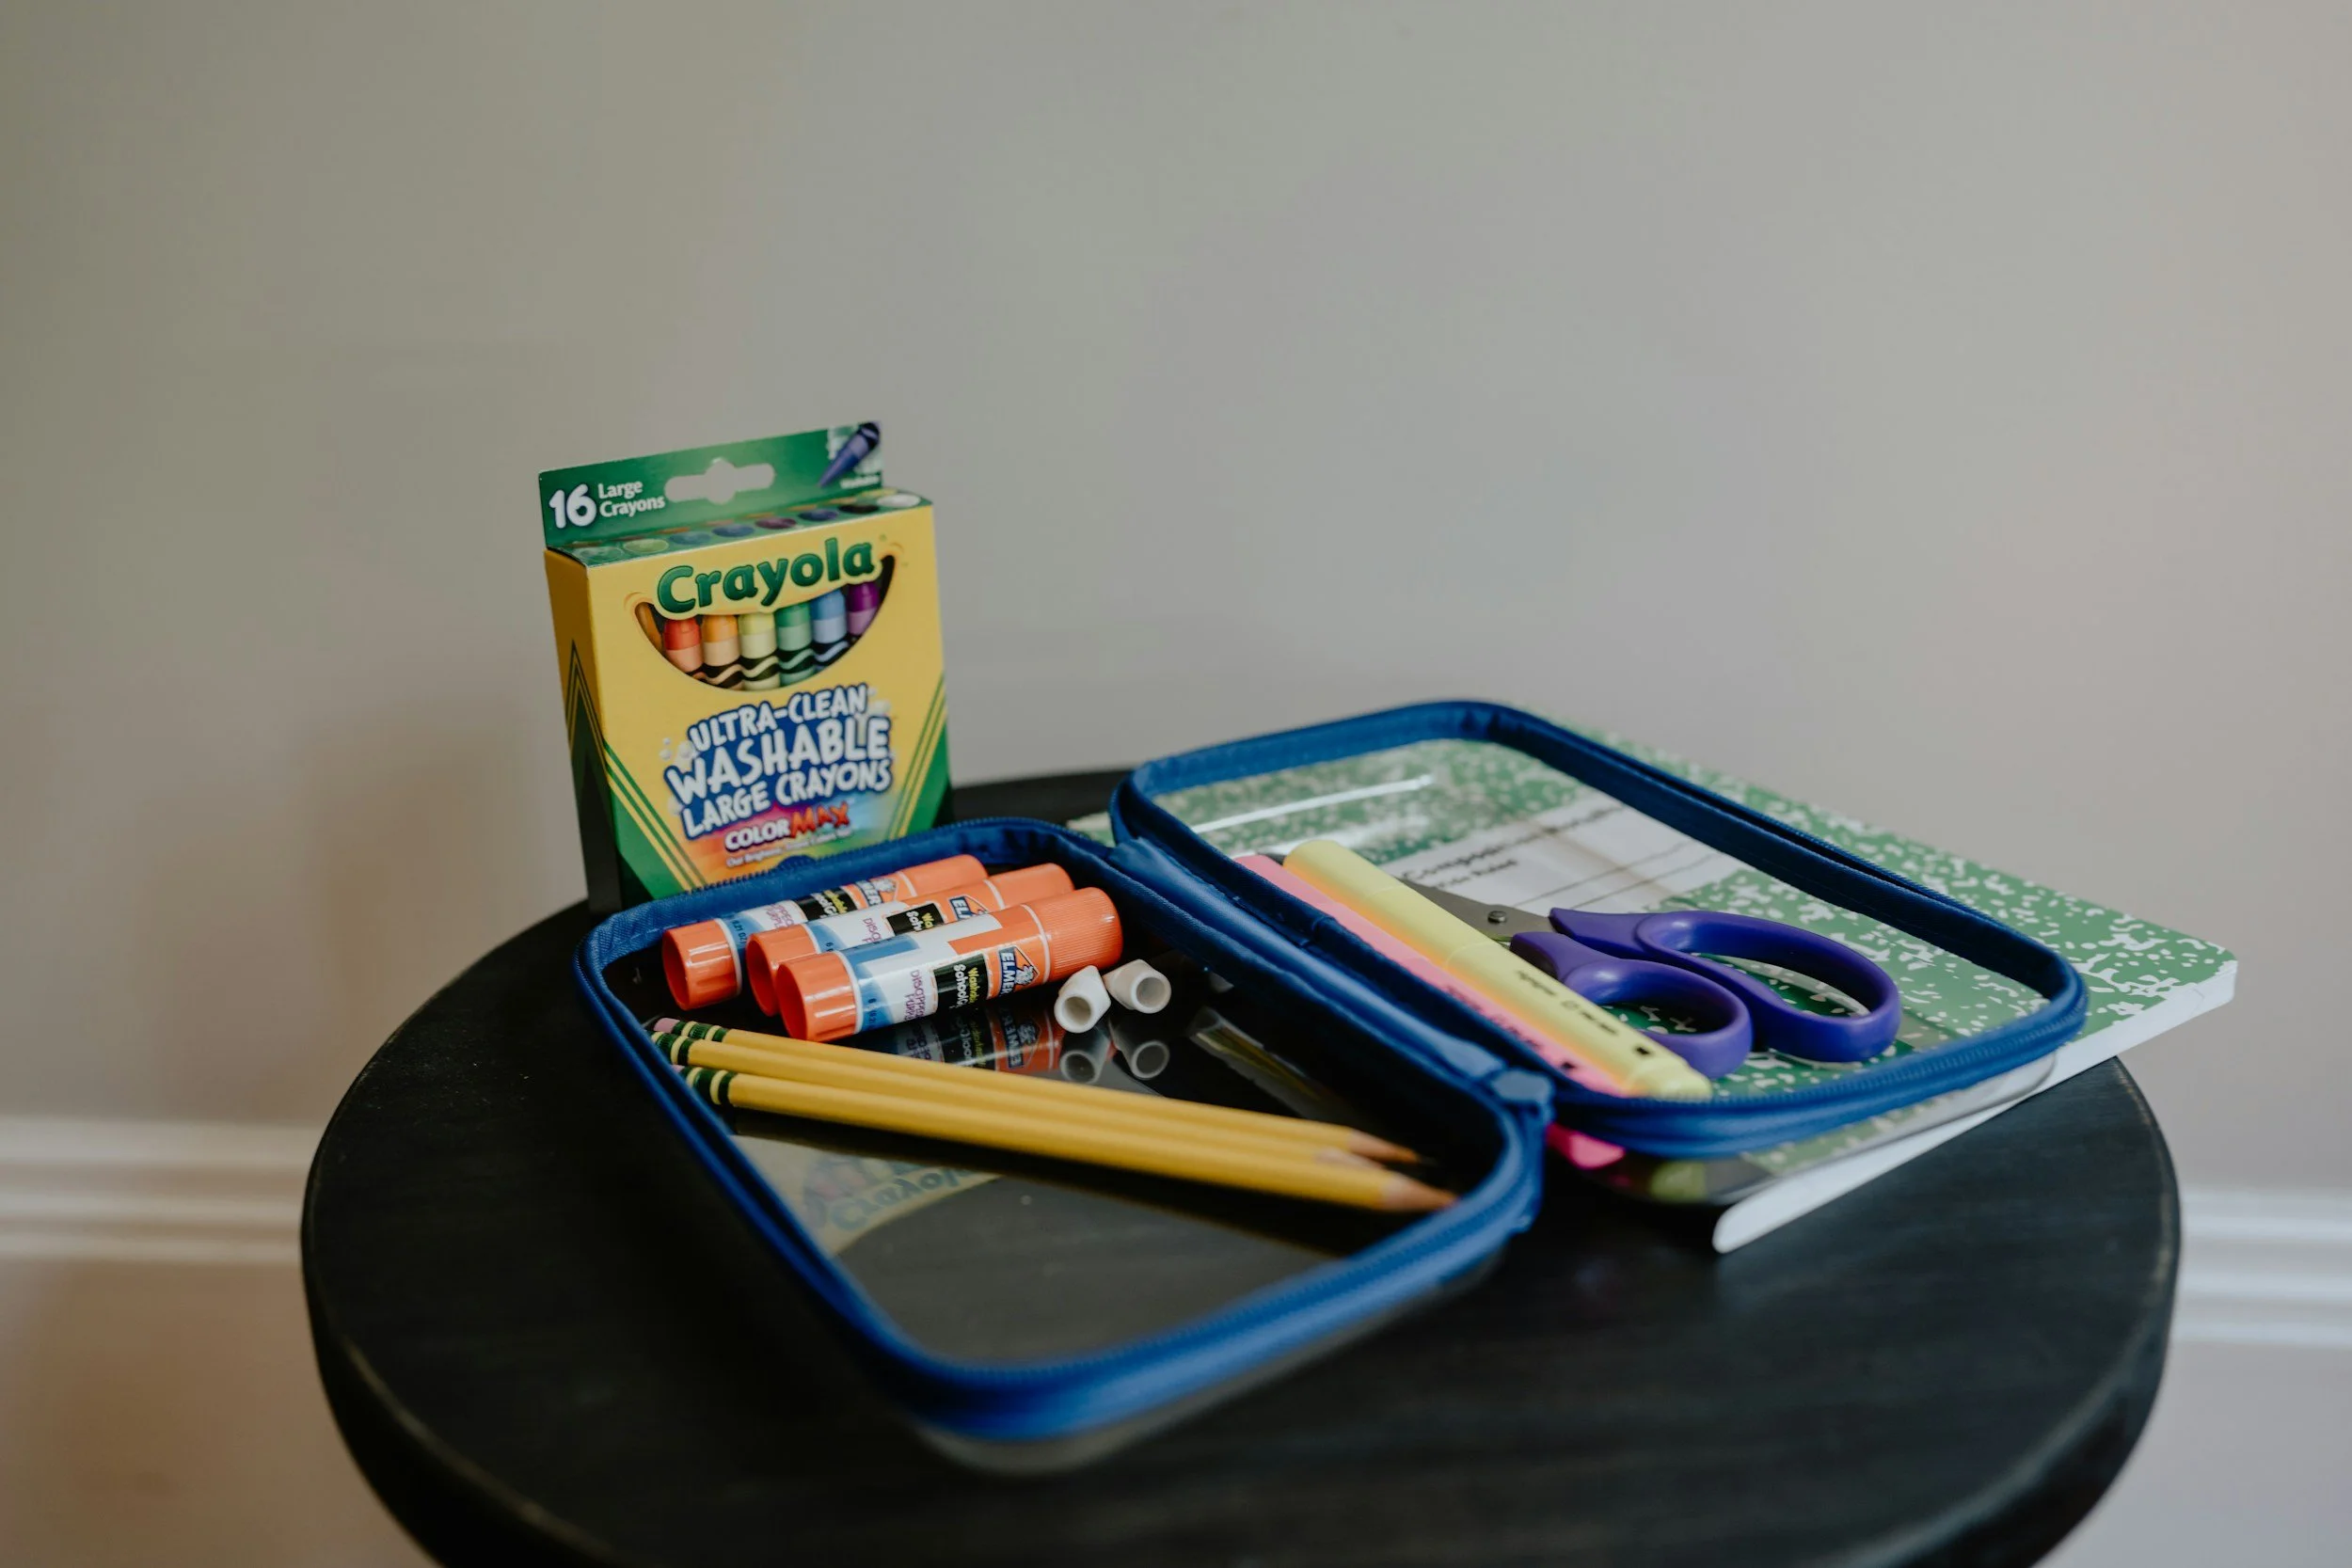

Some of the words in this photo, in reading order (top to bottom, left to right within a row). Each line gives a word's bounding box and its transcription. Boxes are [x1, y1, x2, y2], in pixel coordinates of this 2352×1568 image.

[548, 483, 597, 529] 16
[598, 479, 644, 499] Large
[599, 495, 665, 518] Crayons
[658, 537, 876, 614] Crayola
[689, 684, 867, 752] ULTRA-CLEAN
[665, 717, 891, 805] WASHABLE
[681, 781, 768, 838] LARGE
[775, 761, 892, 804] CRAYONS
[1000, 951, 1016, 995] ELMER
